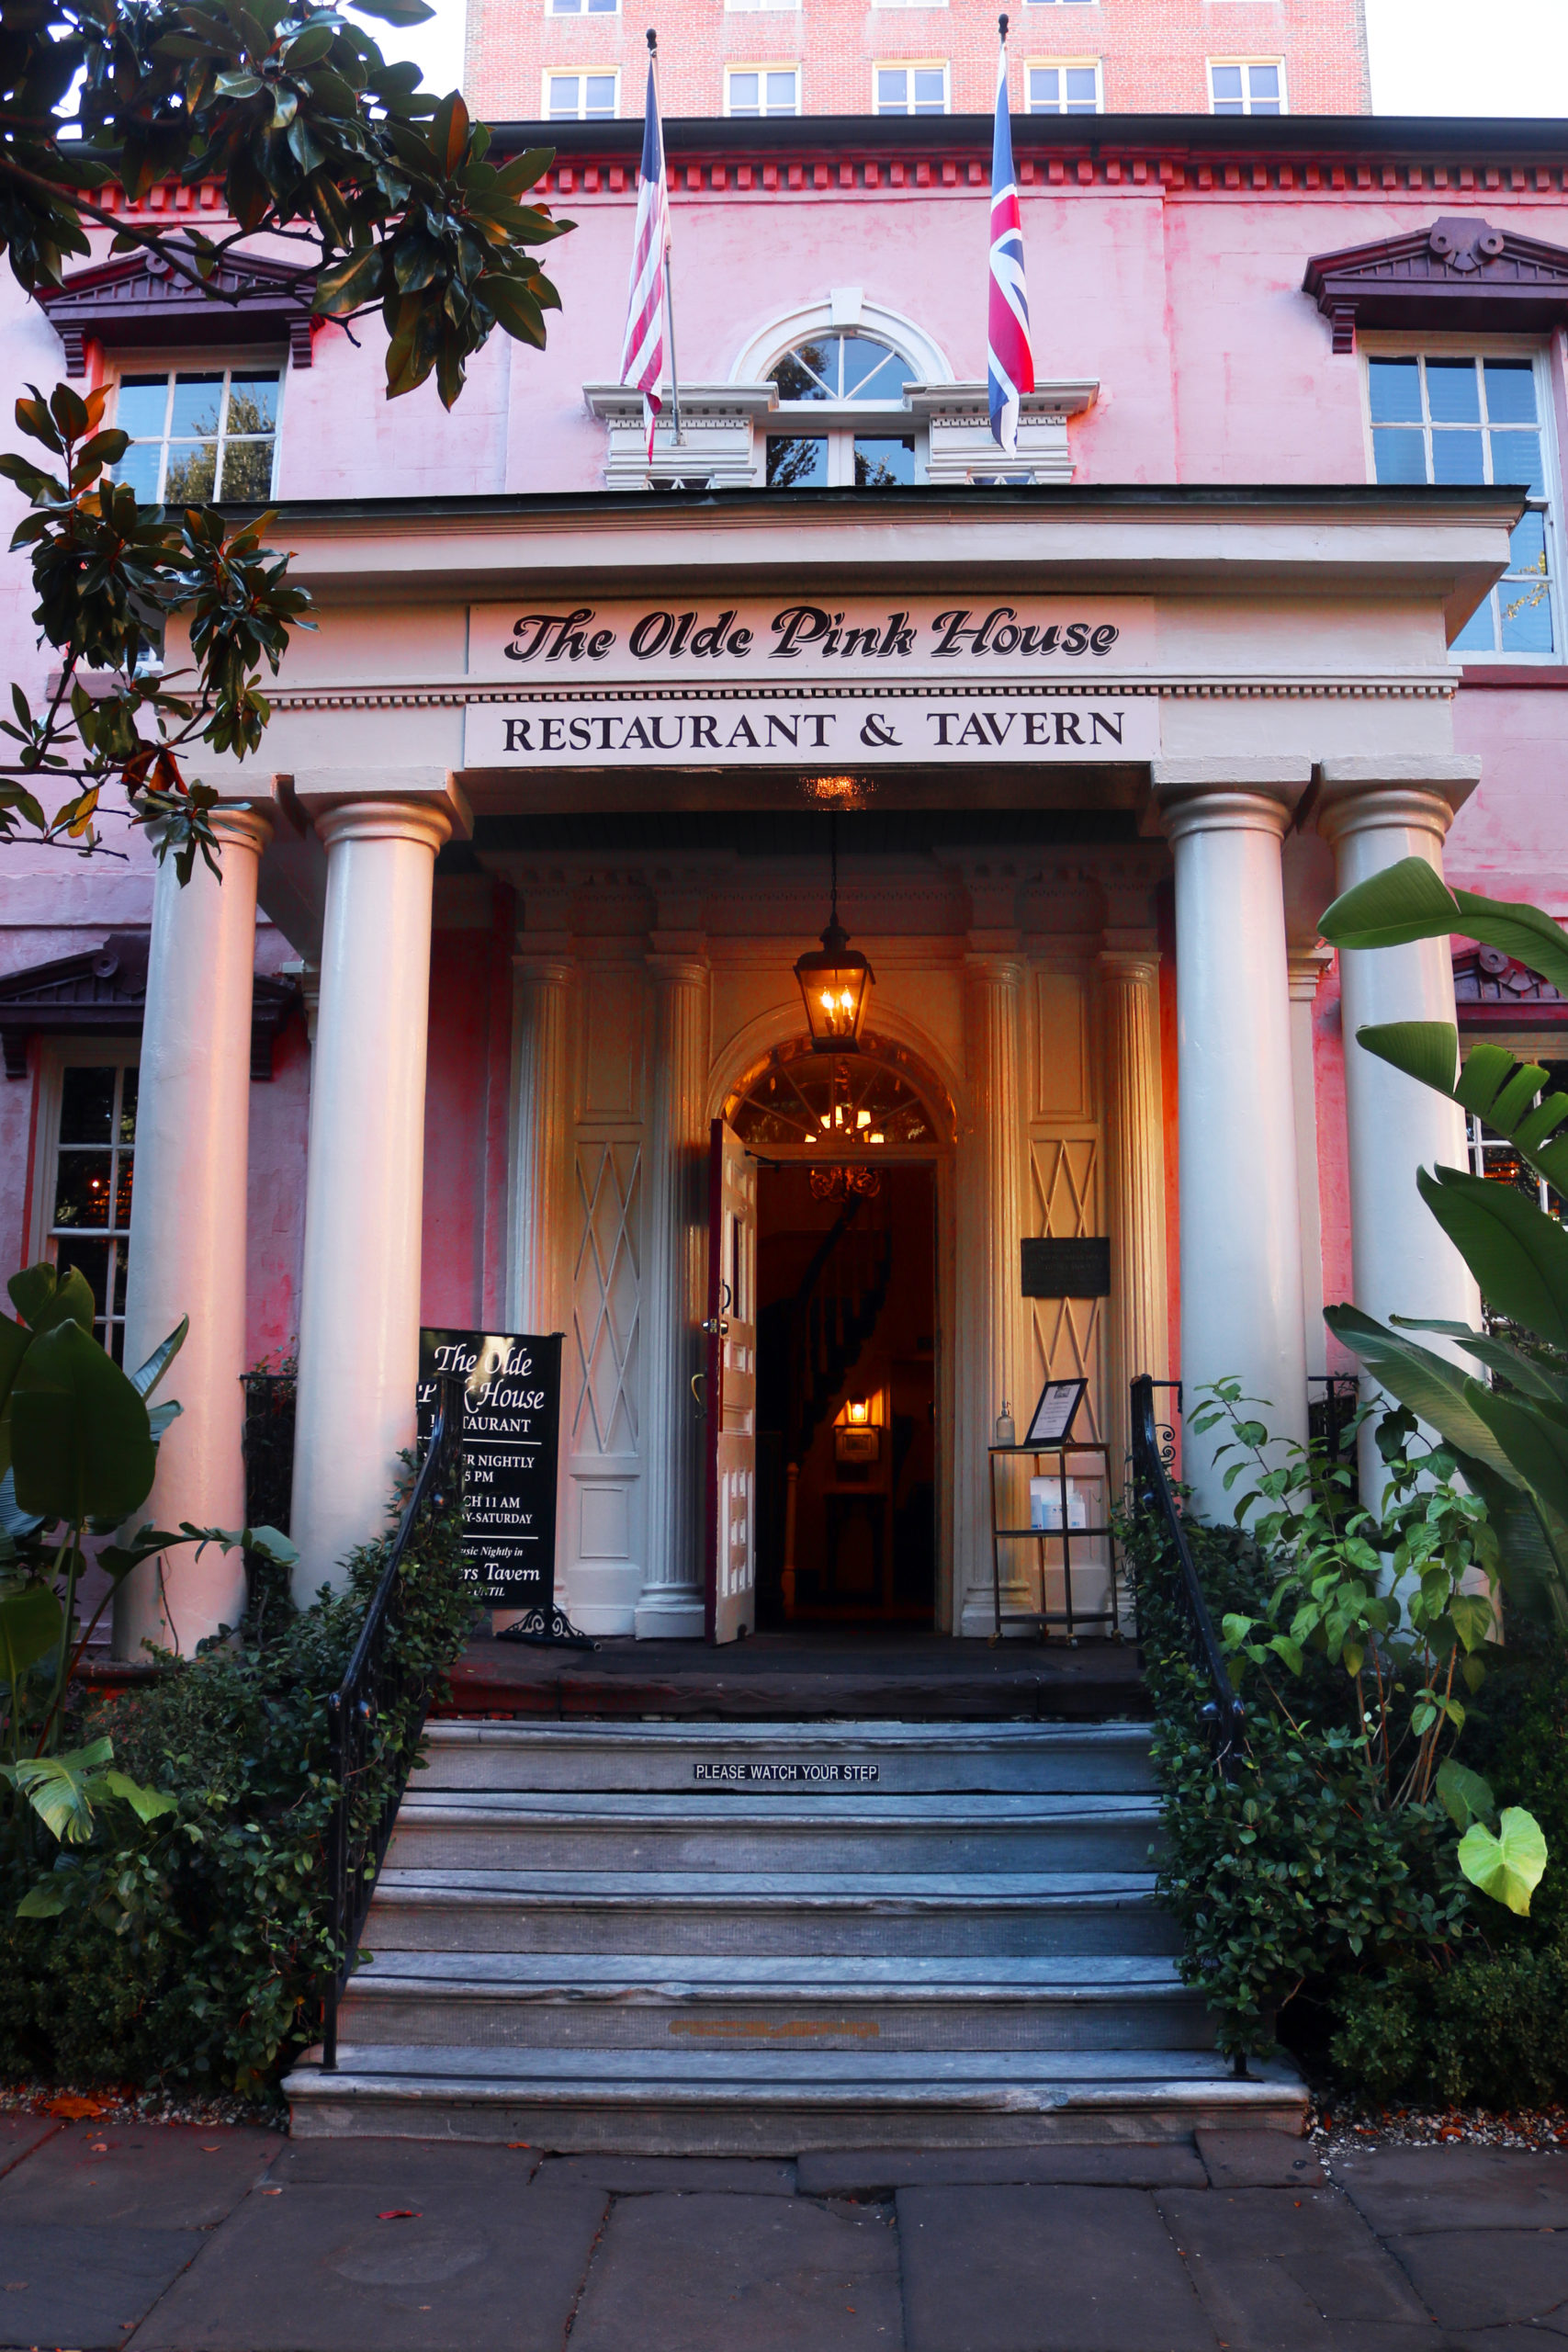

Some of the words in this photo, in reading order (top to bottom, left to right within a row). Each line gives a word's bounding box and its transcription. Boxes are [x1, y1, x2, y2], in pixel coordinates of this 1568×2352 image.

[503, 608, 616, 663] The
[628, 610, 754, 660] Olde
[768, 605, 918, 659] Pink
[931, 607, 1120, 658] House
[502, 713, 837, 752] RESTAURANT
[859, 713, 903, 747] &
[926, 711, 1125, 746] TAVERN
[434, 1342, 478, 1373] The
[484, 1347, 533, 1377] Olde
[477, 1379, 545, 1410] House
[478, 1454, 535, 1468] NIGHTLY
[474, 1471, 494, 1483] PM
[485, 1497, 497, 1508] 11
[500, 1497, 521, 1509] AM
[480, 1546, 513, 1558] Nightly
[514, 1547, 524, 1556] in
[484, 1563, 540, 1581] Tavern
[696, 1765, 746, 1780] PLEASE
[750, 1765, 797, 1780] WATCH
[802, 1765, 839, 1780] YOUR
[843, 1766, 877, 1781] STEP
